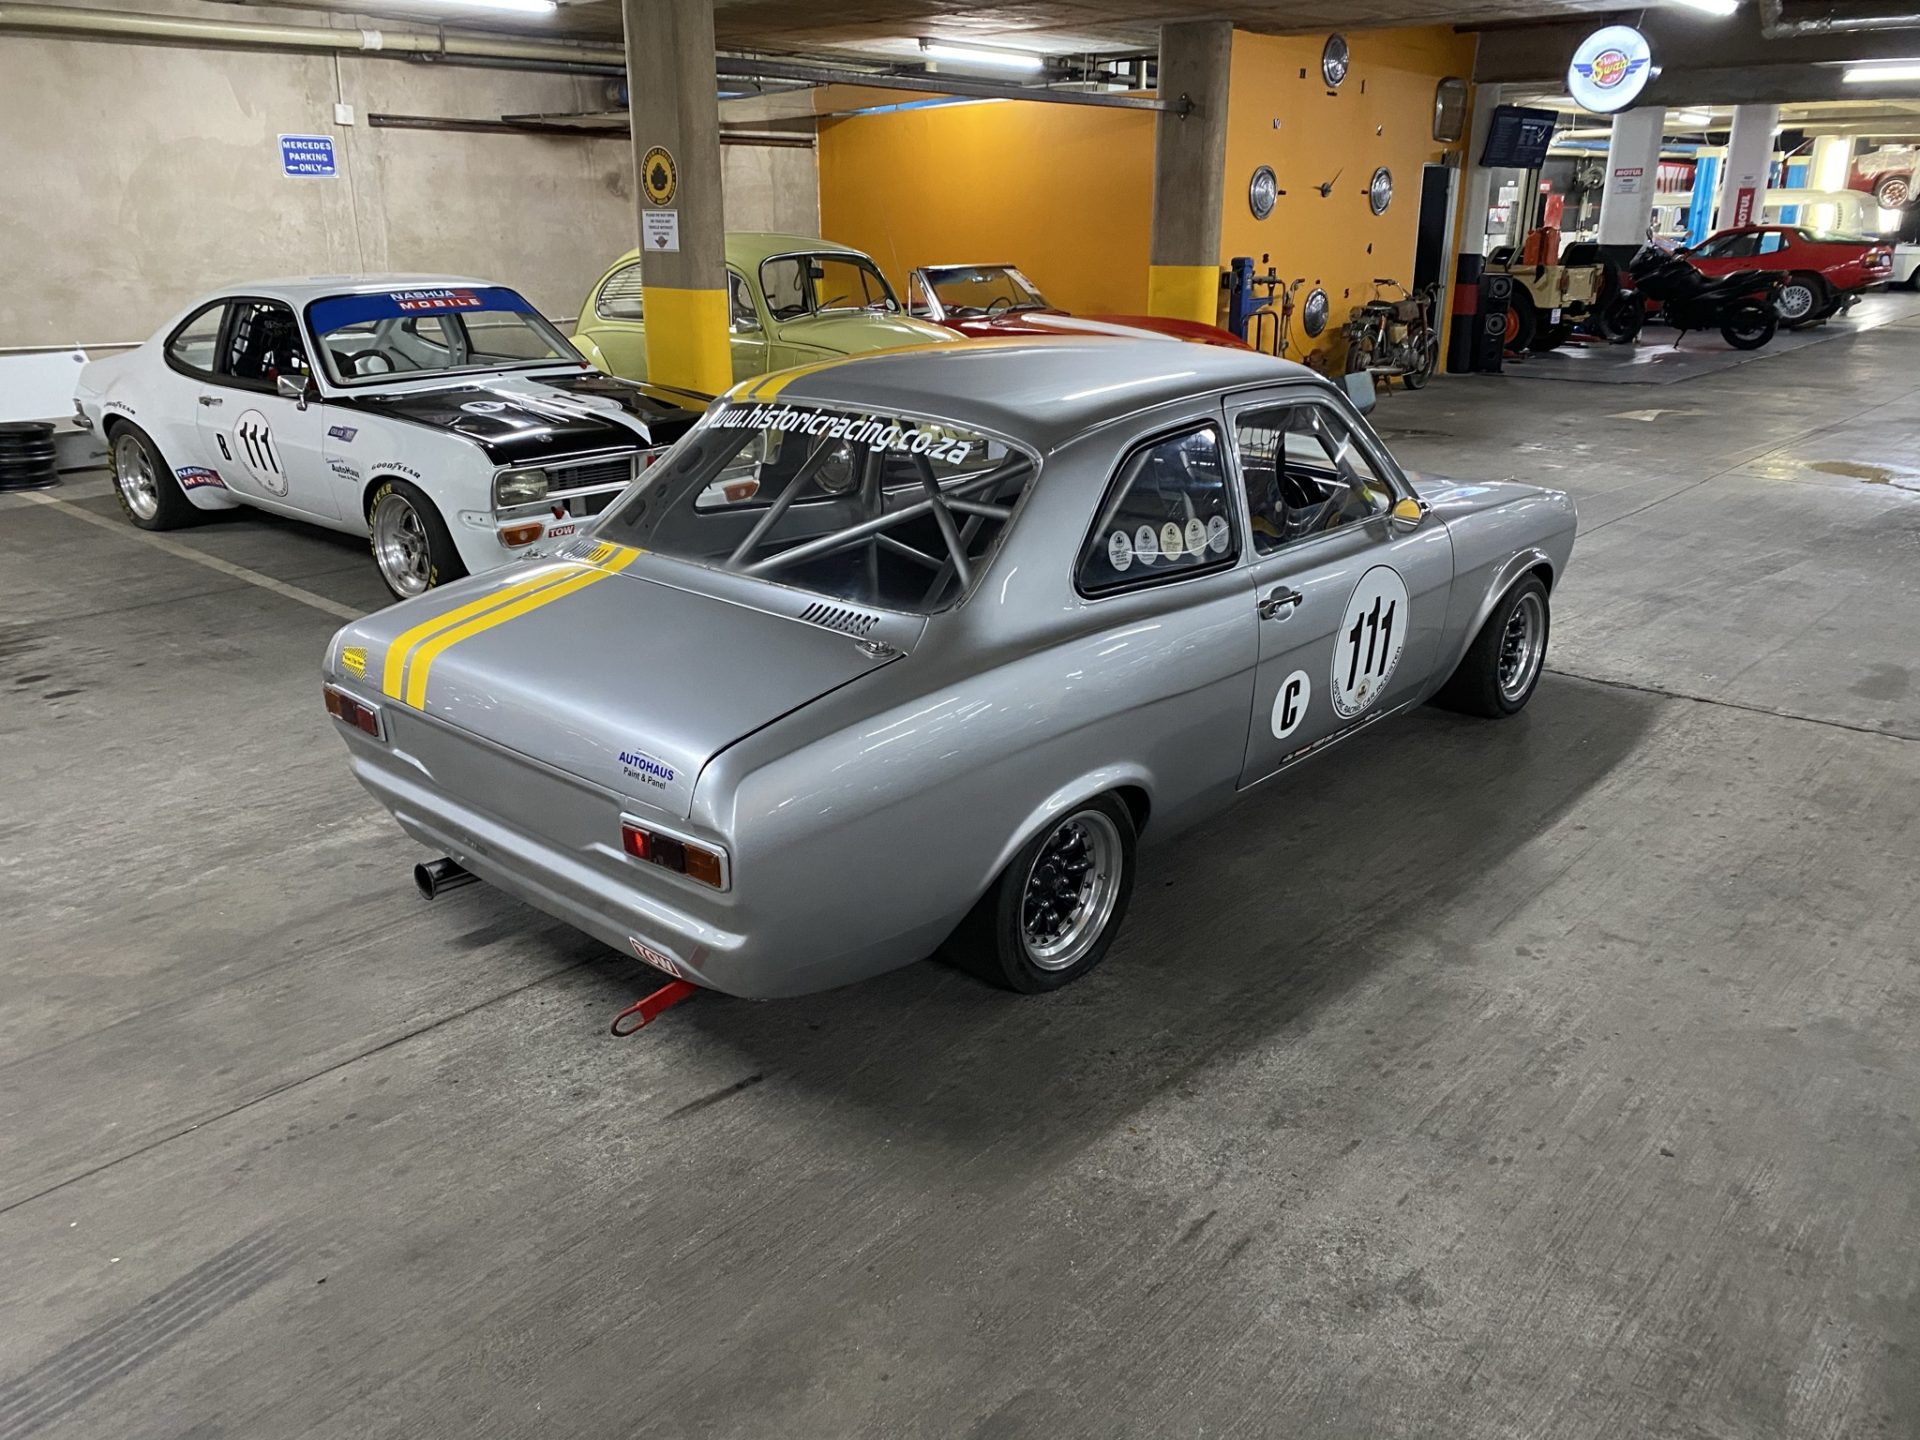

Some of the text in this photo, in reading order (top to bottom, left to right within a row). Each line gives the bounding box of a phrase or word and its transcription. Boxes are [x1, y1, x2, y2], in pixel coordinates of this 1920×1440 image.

[282, 141, 331, 150] MERCEDES
[289, 152, 328, 162] PARKING
[299, 163, 322, 172] ONLY
[1616, 168, 1643, 177] MOTUL
[389, 290, 456, 301] NASHUA
[399, 298, 481, 310] MOBILE
[215, 433, 233, 461] B
[239, 421, 279, 474] 111
[371, 461, 421, 479] GOODYEAR
[550, 525, 574, 537] TOW
[1346, 596, 1396, 691] 111
[1280, 679, 1301, 731] C
[1362, 692, 1375, 707] CAR
[619, 751, 675, 781] AUTOHAUS
[623, 766, 666, 790] Paint & Panel
[633, 942, 673, 972] TOW
